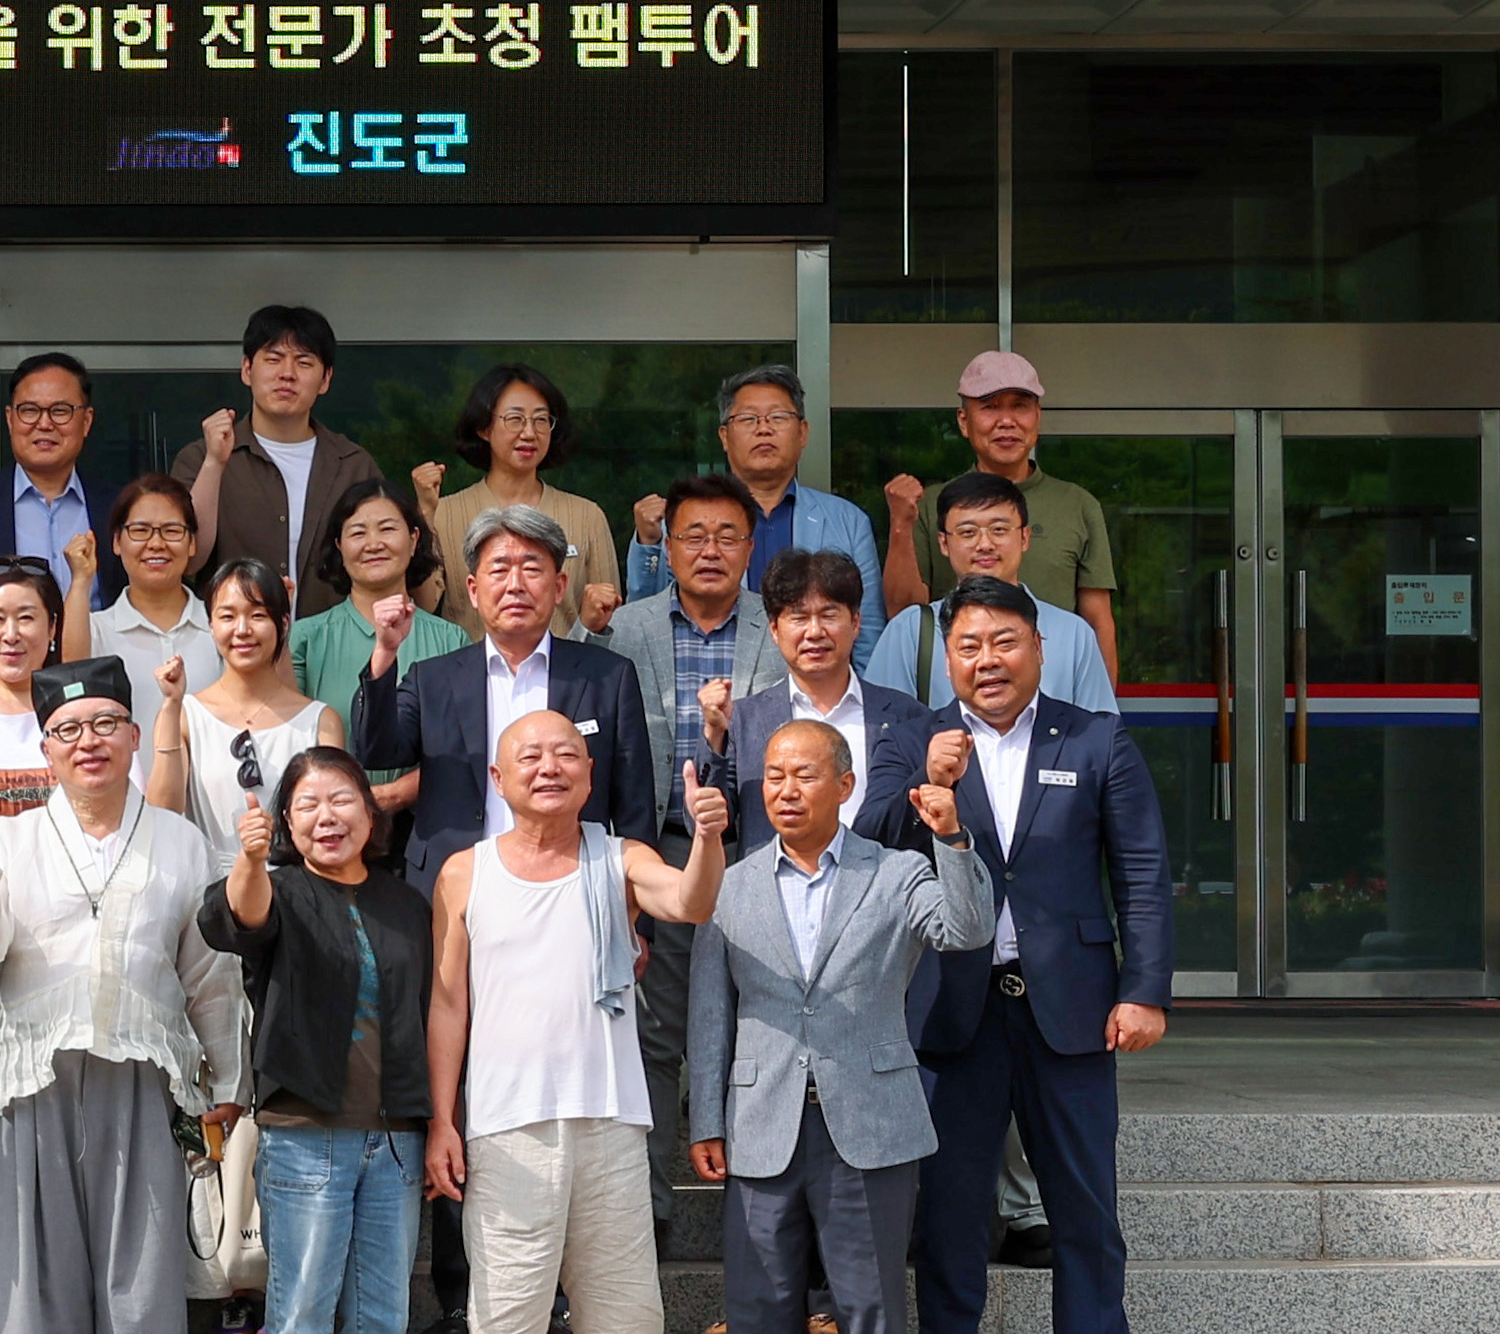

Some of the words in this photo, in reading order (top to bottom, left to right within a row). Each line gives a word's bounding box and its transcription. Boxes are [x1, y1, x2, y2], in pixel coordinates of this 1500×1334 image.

[46, 4, 174, 70] 위한
[200, 3, 393, 70] 전문가
[418, 3, 543, 69] 초청
[570, 3, 760, 69] 팸투어
[286, 111, 469, 175] 진도군
